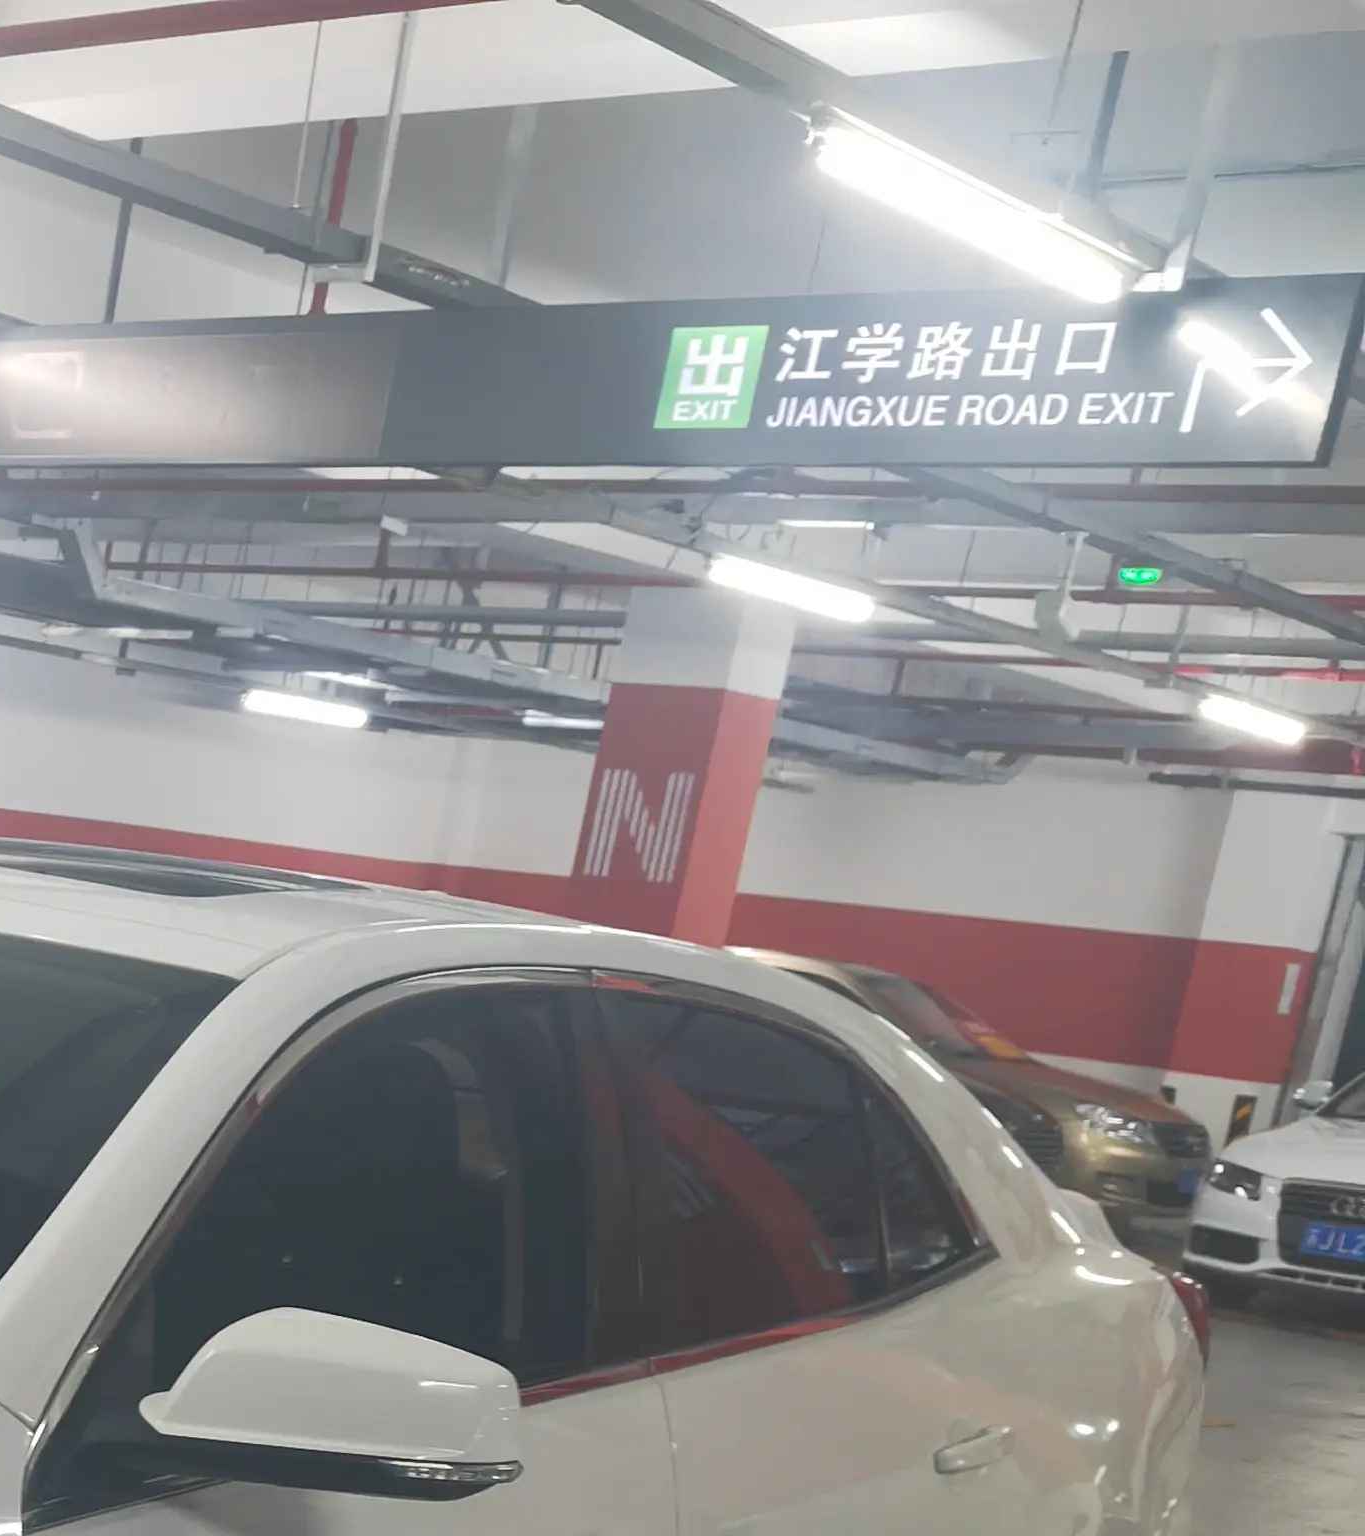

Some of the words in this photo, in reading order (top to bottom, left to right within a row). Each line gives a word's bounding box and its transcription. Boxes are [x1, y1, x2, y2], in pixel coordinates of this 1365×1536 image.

[677, 333, 750, 397] 出
[775, 318, 1118, 384] 江学路出口
[672, 399, 738, 422] EXIT
[765, 394, 951, 428] JIANGXUE
[955, 393, 1070, 427] ROAD
[1077, 391, 1175, 425] EXIT
[582, 767, 696, 884] N
